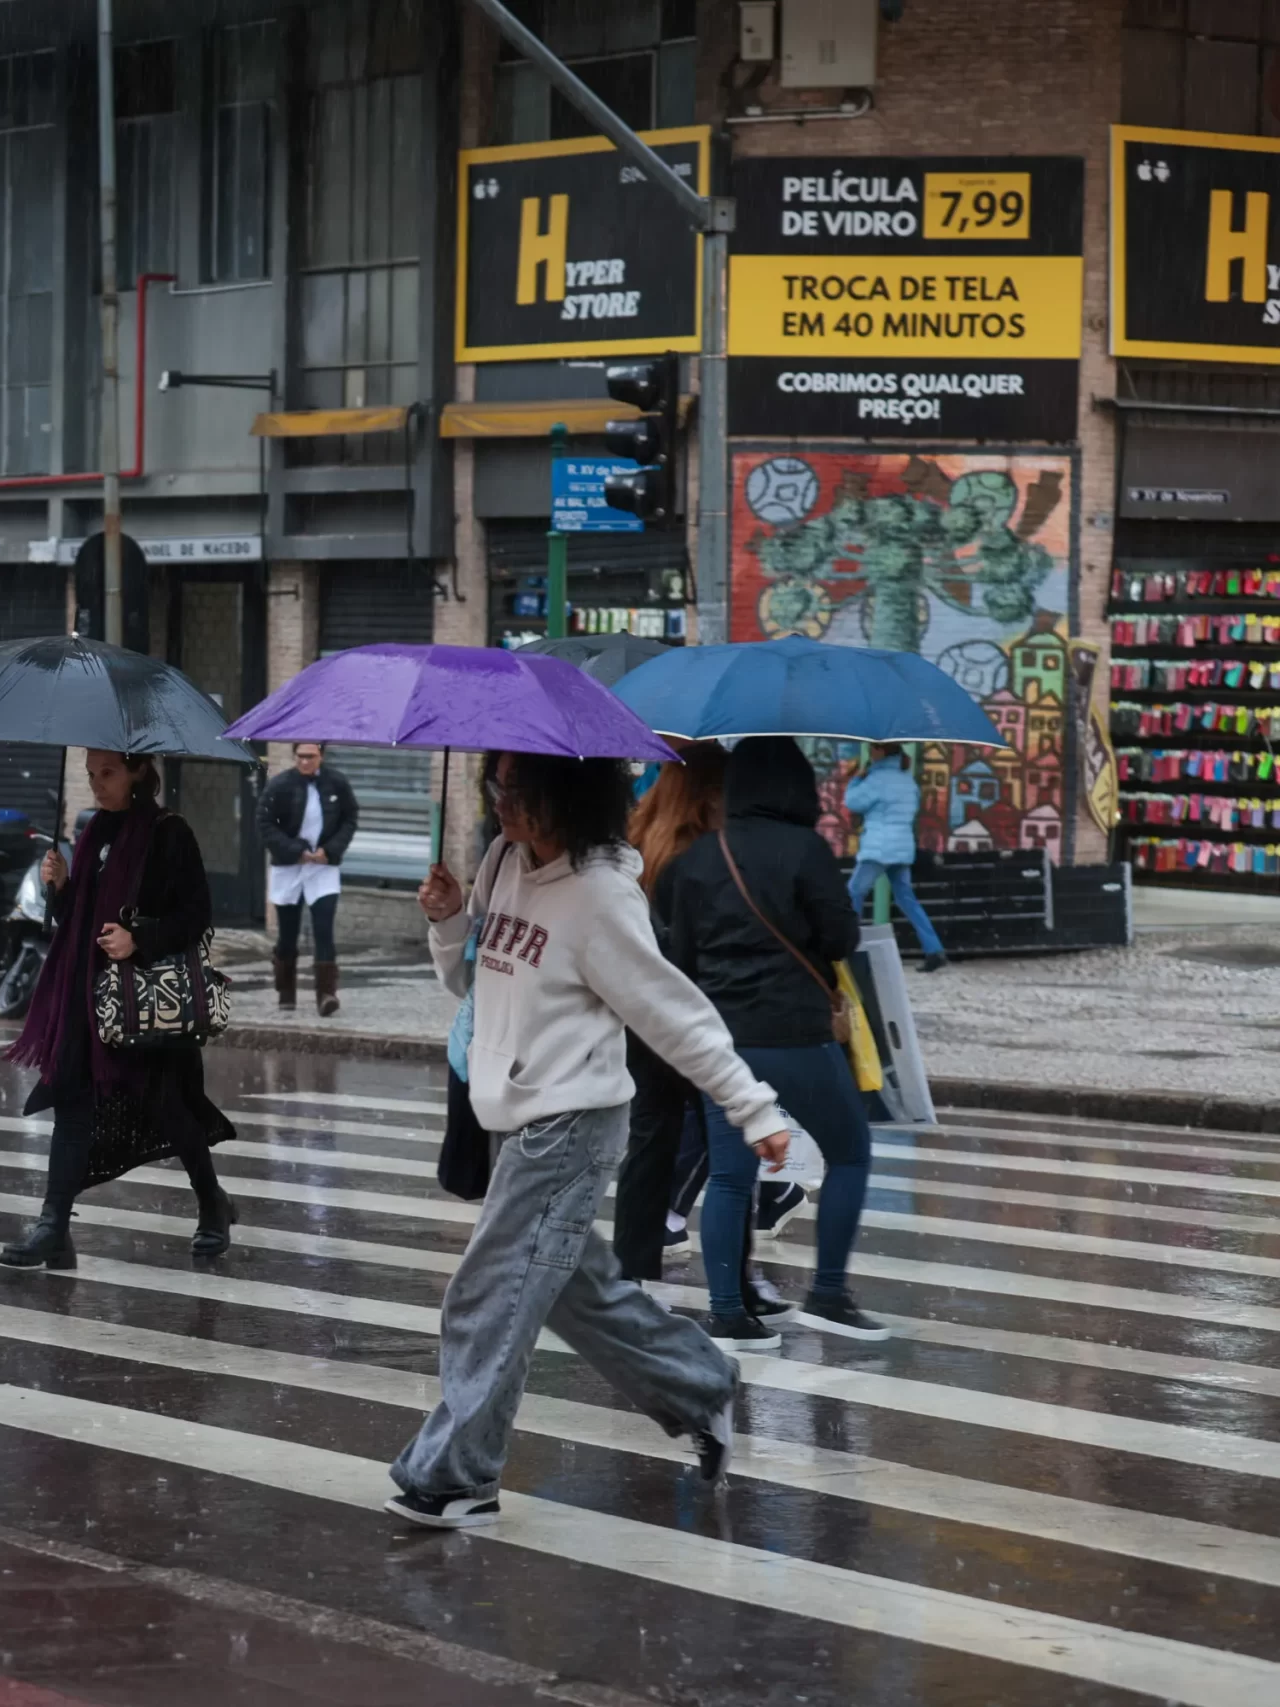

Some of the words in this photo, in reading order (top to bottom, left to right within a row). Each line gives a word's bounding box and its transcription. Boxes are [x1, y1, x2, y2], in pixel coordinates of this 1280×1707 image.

[783, 170, 918, 201] PELÍCULA
[782, 211, 819, 236] DE
[822, 211, 917, 236] VIDRO
[939, 191, 1025, 233] 7,99
[783, 275, 890, 301] TROCA
[900, 276, 937, 301] DE
[945, 276, 1020, 301] TELA
[561, 291, 641, 320] STORE
[782, 312, 825, 337] EM
[833, 312, 873, 337] 40
[882, 313, 1026, 338] MINUTOS
[777, 372, 897, 393] COBRIMOS
[901, 374, 1025, 397] QUALQUER
[858, 400, 940, 424] PREÇO!
